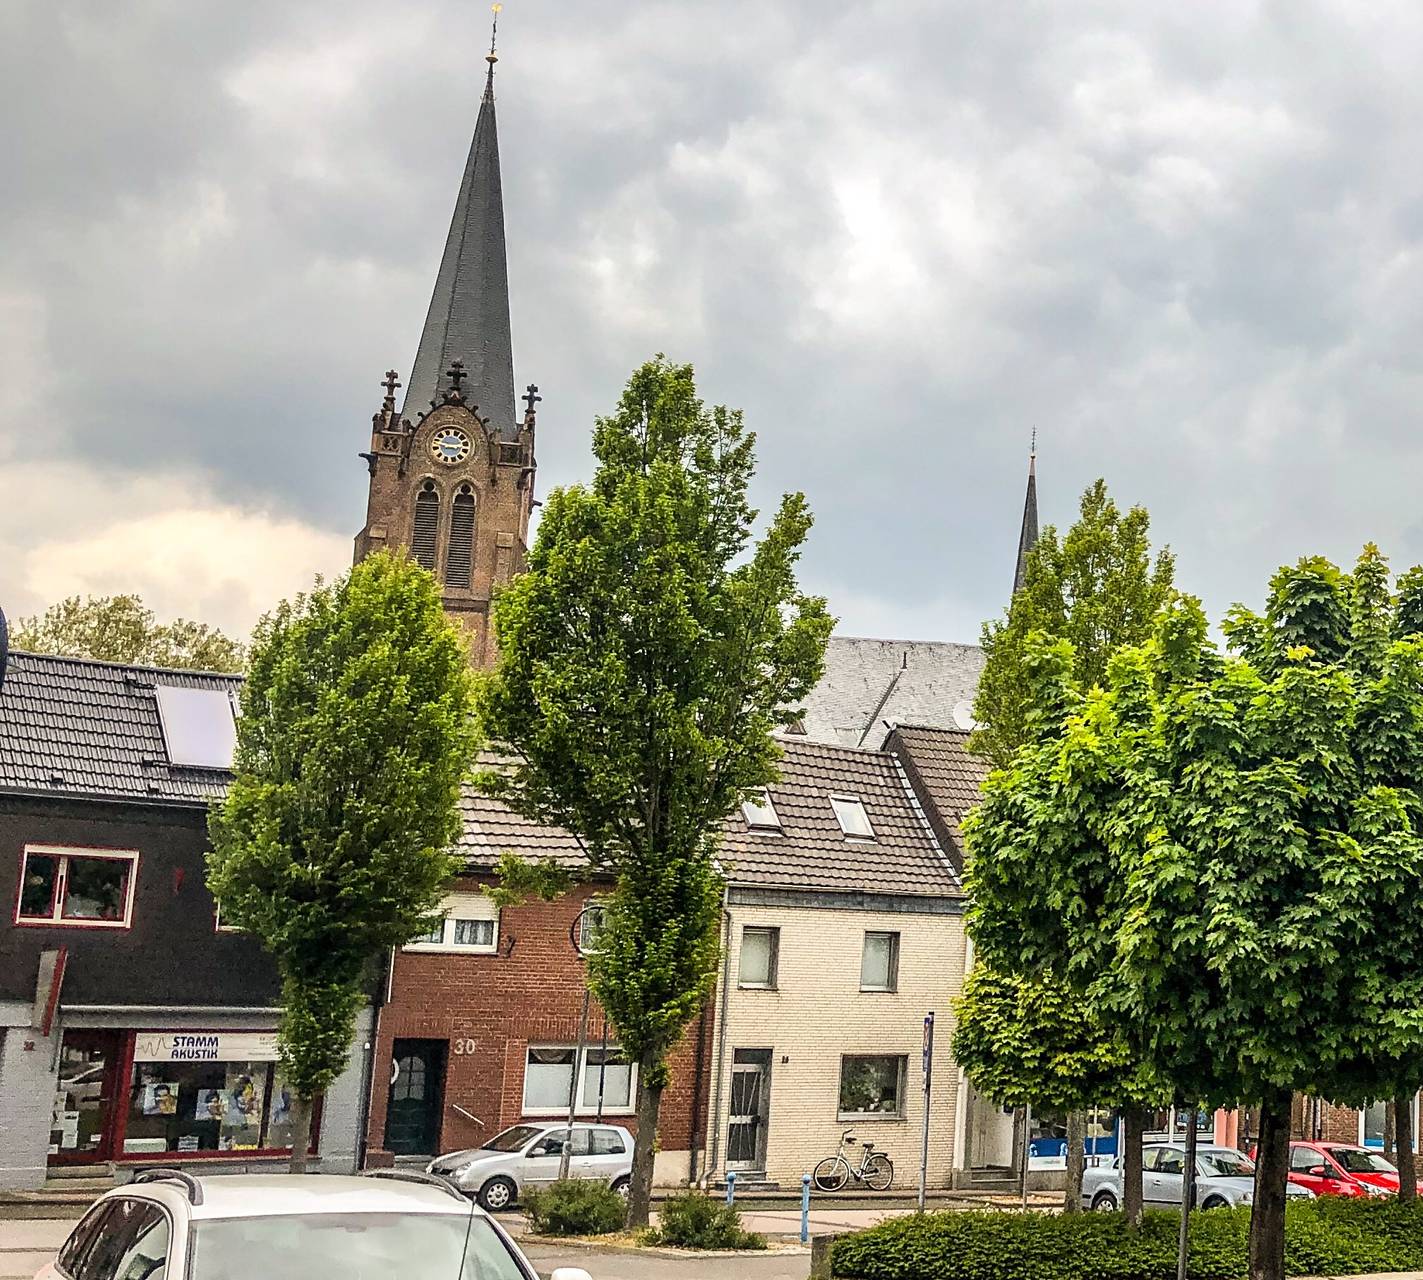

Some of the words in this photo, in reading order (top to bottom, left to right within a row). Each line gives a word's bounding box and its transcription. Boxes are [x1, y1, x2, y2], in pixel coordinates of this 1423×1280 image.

[173, 1036, 219, 1047] STAMM
[454, 1039, 475, 1055] 30
[171, 1049, 218, 1059] AKUSTIK
